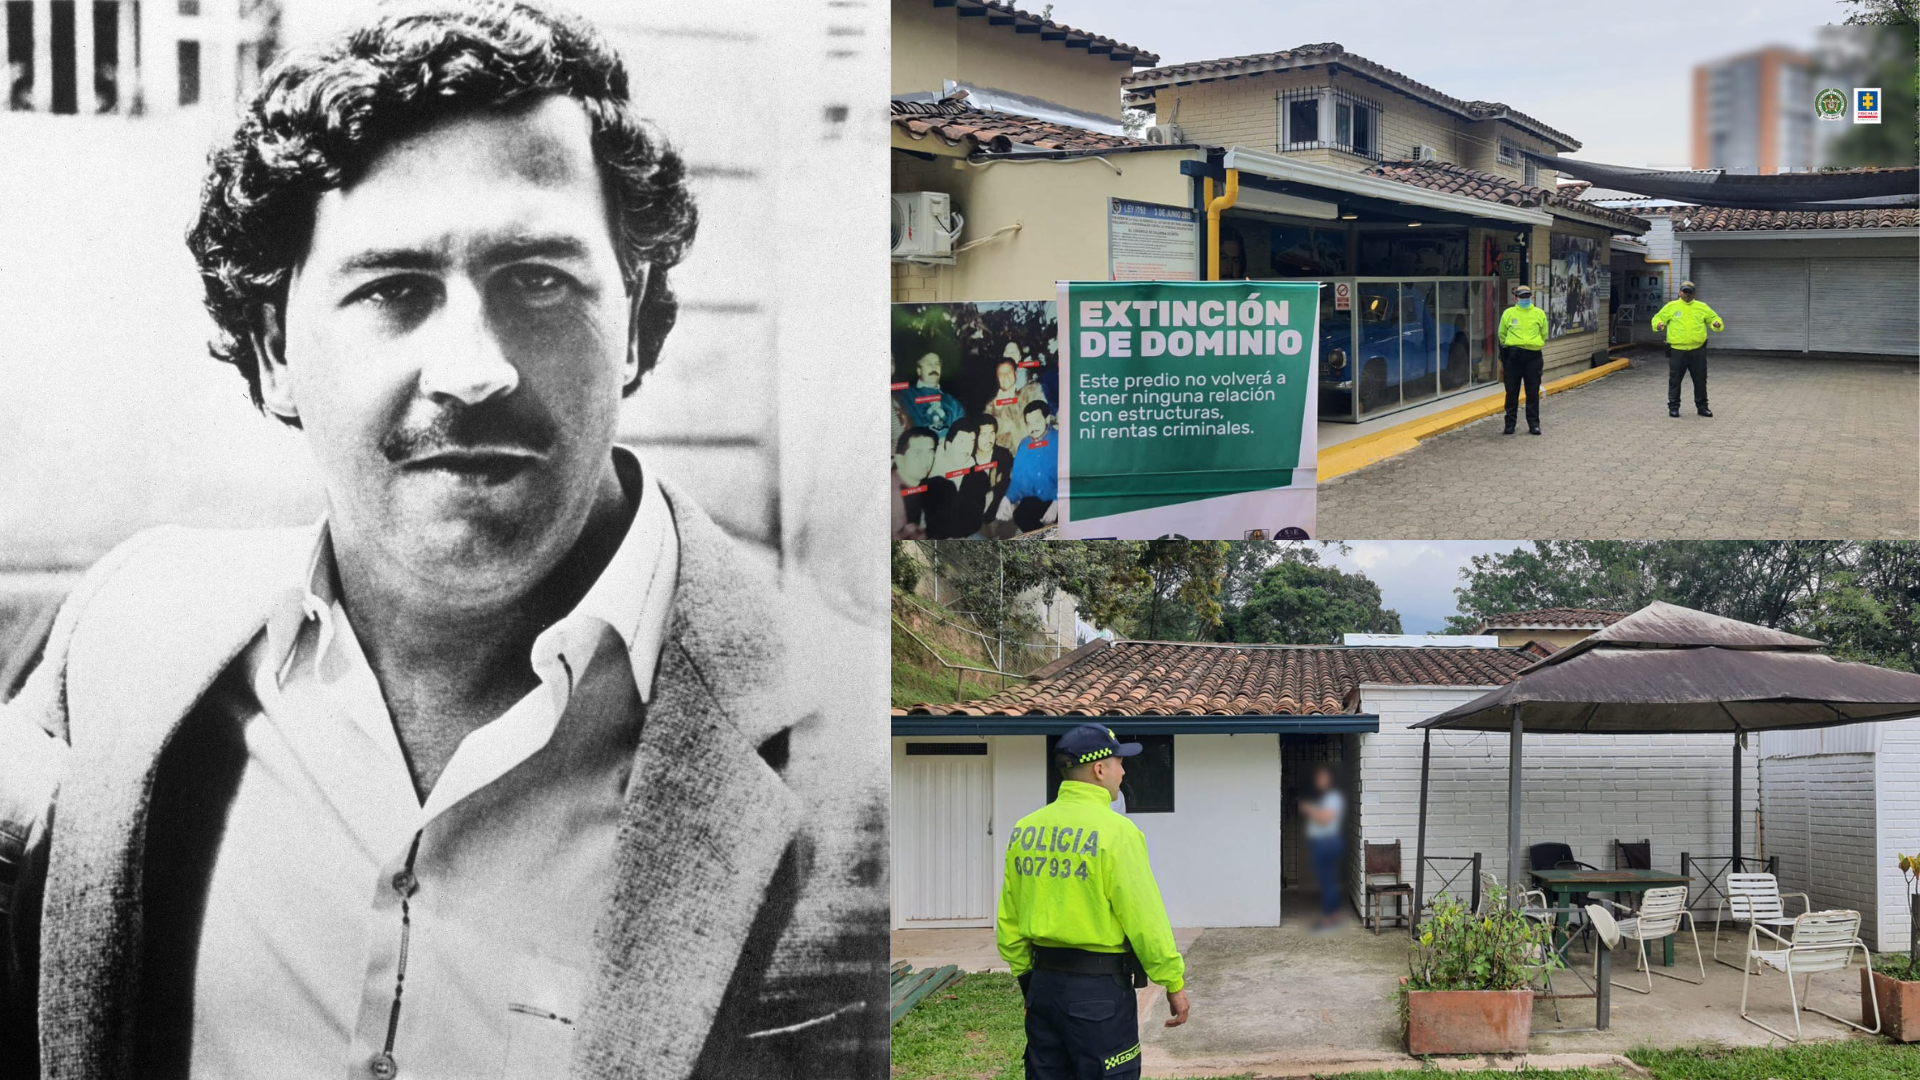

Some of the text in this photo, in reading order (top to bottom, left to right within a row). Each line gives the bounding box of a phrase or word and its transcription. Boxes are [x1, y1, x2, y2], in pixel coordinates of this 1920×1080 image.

[1124, 204, 1134, 213] LEY
[1158, 209, 1165, 217] DE
[1079, 293, 1289, 327] EXTINCIÓN
[1079, 330, 1303, 358] DE DOMINIO
[1079, 370, 1286, 391] Este predio no volverá a
[1079, 386, 1275, 407] tener ninguna relación
[1079, 405, 1224, 422] con estructuras,
[1079, 420, 1254, 439] ni rentas criminales.
[1007, 825, 1099, 857] POLICIA
[1014, 856, 1089, 881] 607934
